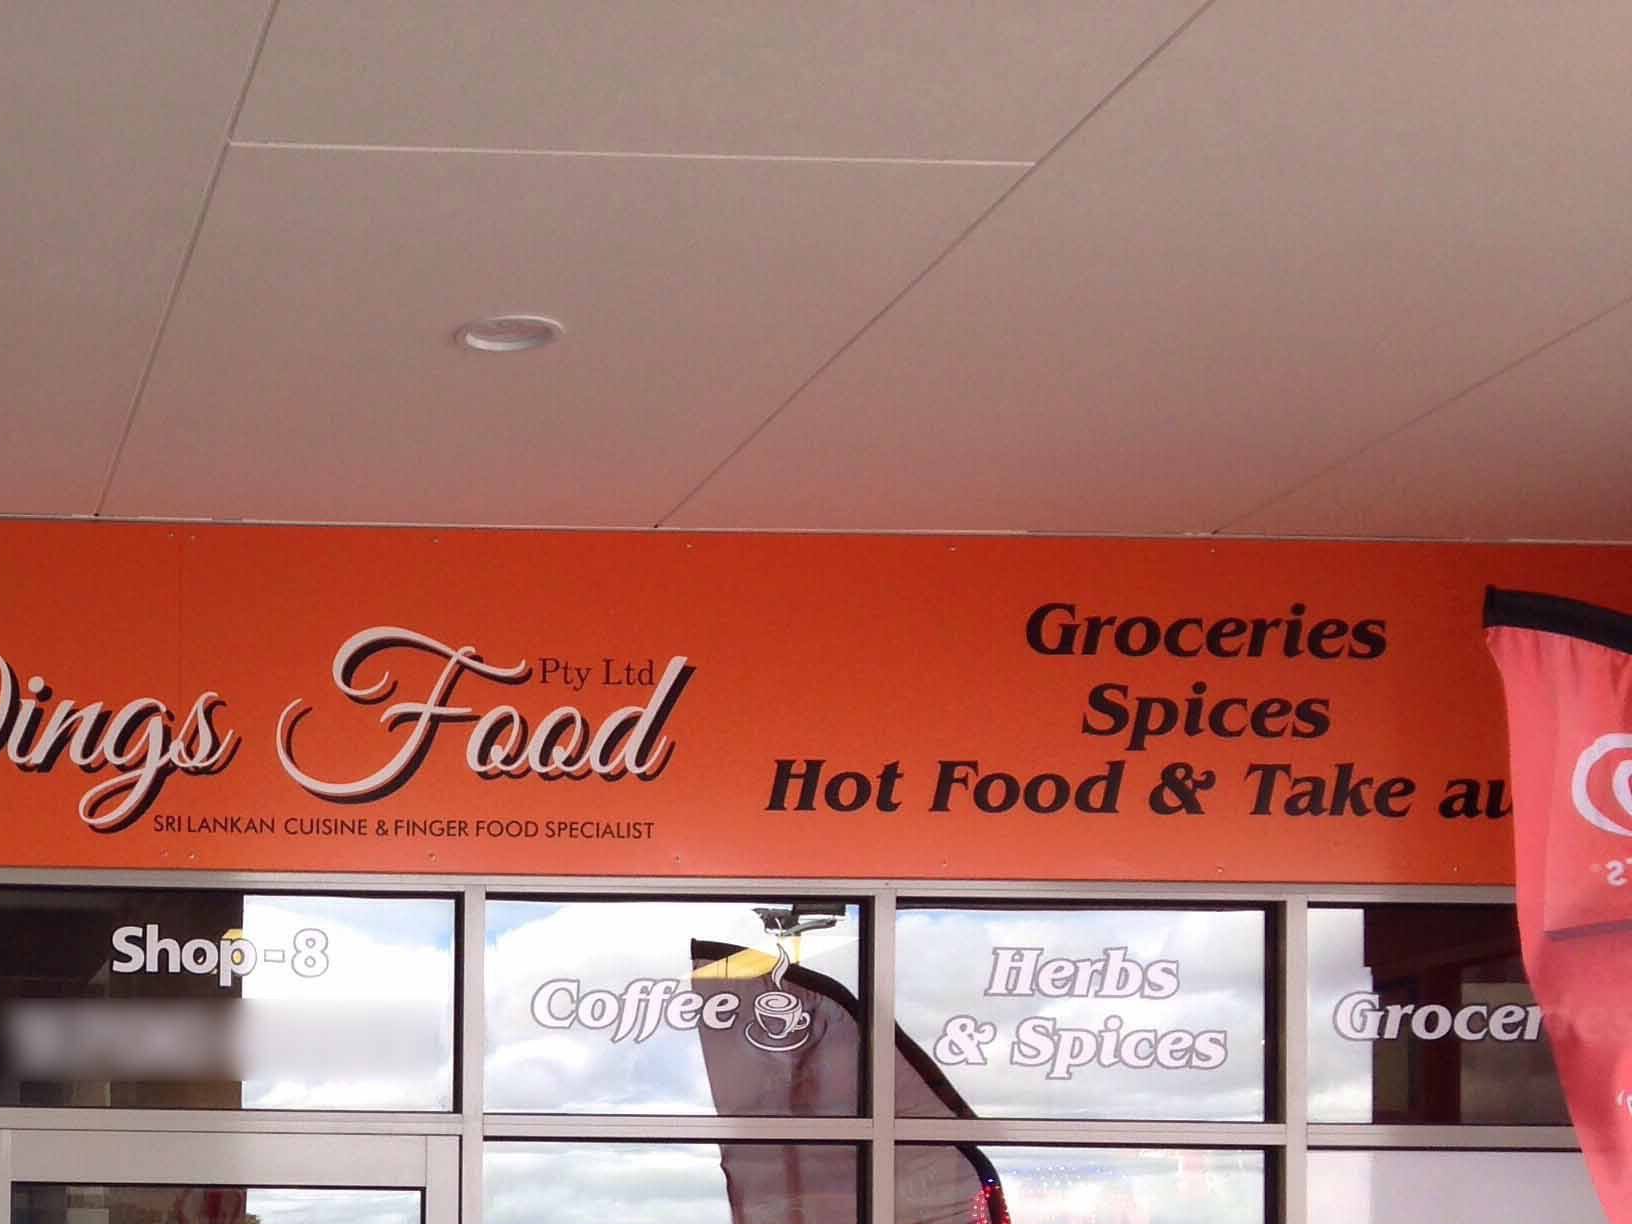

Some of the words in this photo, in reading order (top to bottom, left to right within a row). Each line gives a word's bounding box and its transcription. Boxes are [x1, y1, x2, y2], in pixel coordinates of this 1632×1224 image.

[1025, 601, 1388, 660] Groceries
[539, 657, 591, 692] Pty
[603, 657, 656, 686] Ltd
[276, 626, 696, 805] Food
[1081, 682, 1333, 752] Spices
[766, 759, 902, 813] Hot
[929, 760, 1126, 815] Food
[1148, 761, 1217, 816] &
[1245, 762, 1418, 818] Take
[153, 815, 182, 834] SRI
[187, 815, 276, 835] LANKAN
[284, 817, 368, 837] CUISINE
[375, 819, 389, 837] &
[394, 818, 469, 838] FINGER
[475, 820, 539, 839] FOOD
[544, 820, 655, 840] SPECIALIST
[985, 946, 1181, 1000] Herbs
[531, 978, 740, 1043] Coffee
[934, 1016, 995, 1068] &
[1009, 1015, 1228, 1082] Spices
